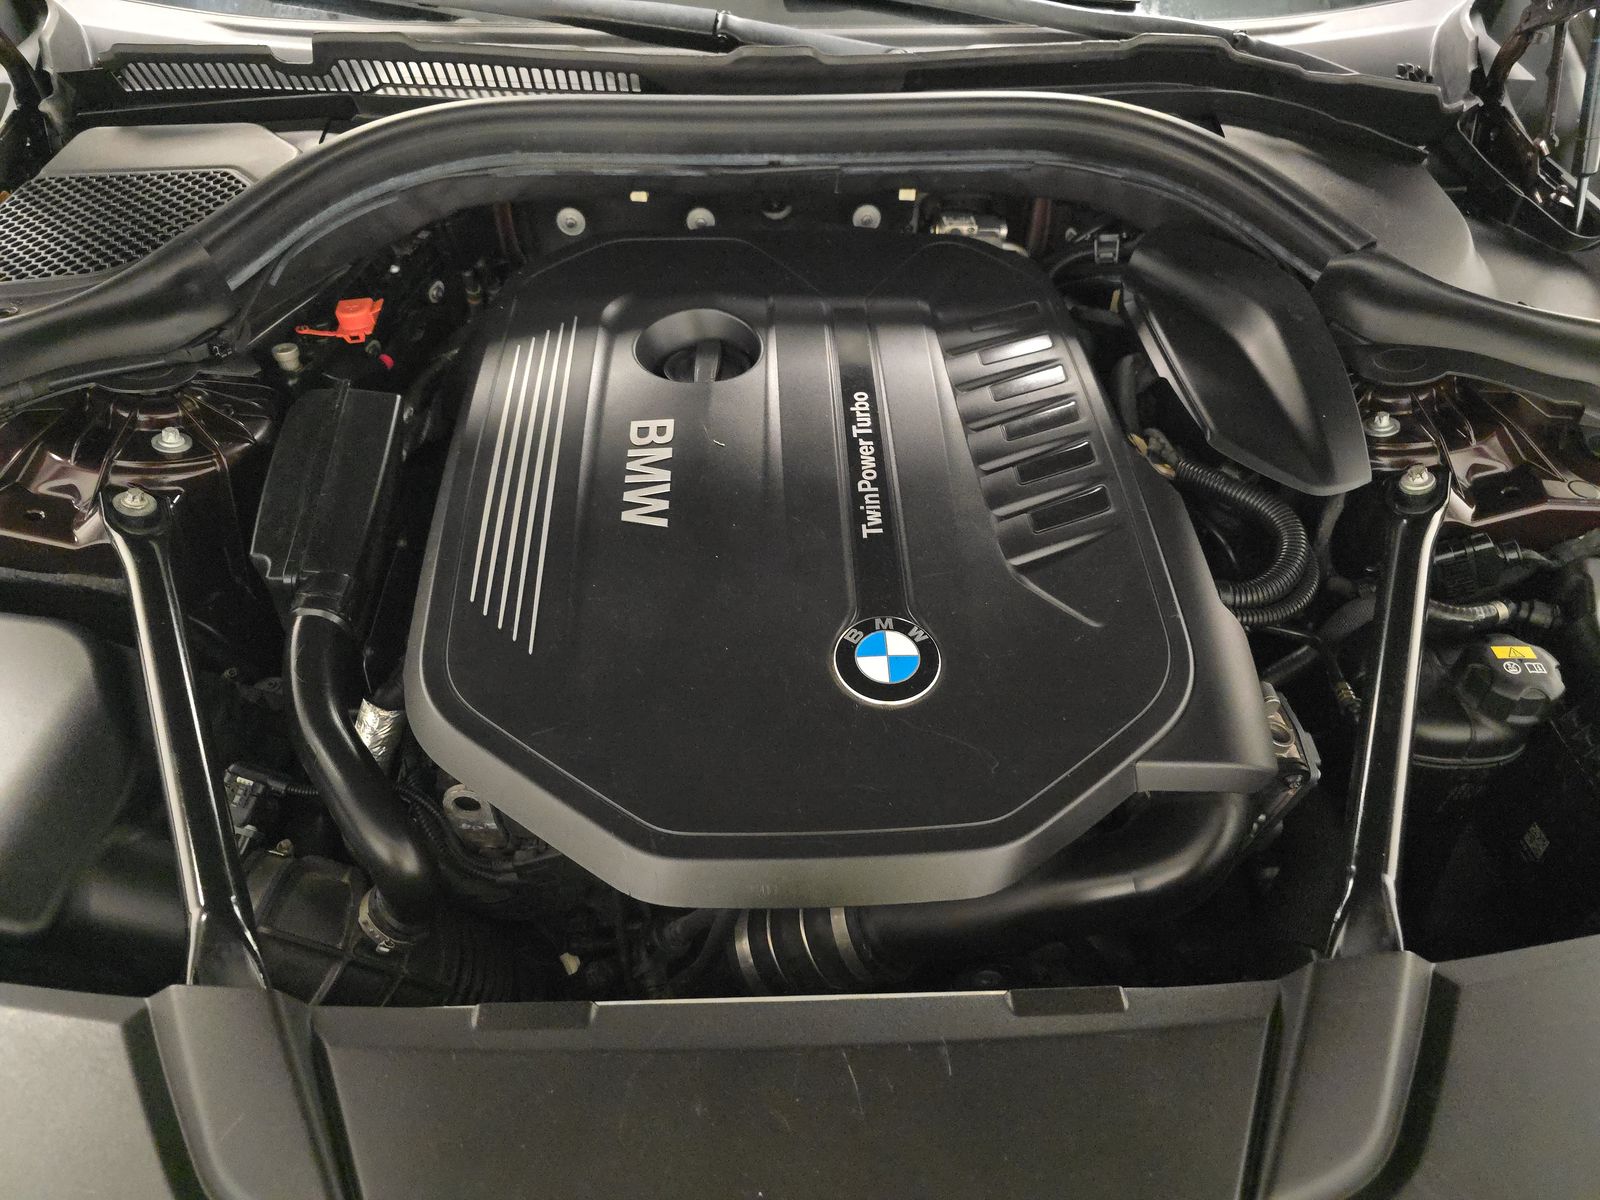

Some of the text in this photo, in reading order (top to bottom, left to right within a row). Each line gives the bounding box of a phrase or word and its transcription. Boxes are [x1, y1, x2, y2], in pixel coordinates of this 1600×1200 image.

[850, 391, 874, 438] Turbo
[621, 418, 675, 527] BMW
[843, 617, 929, 645] BMW
